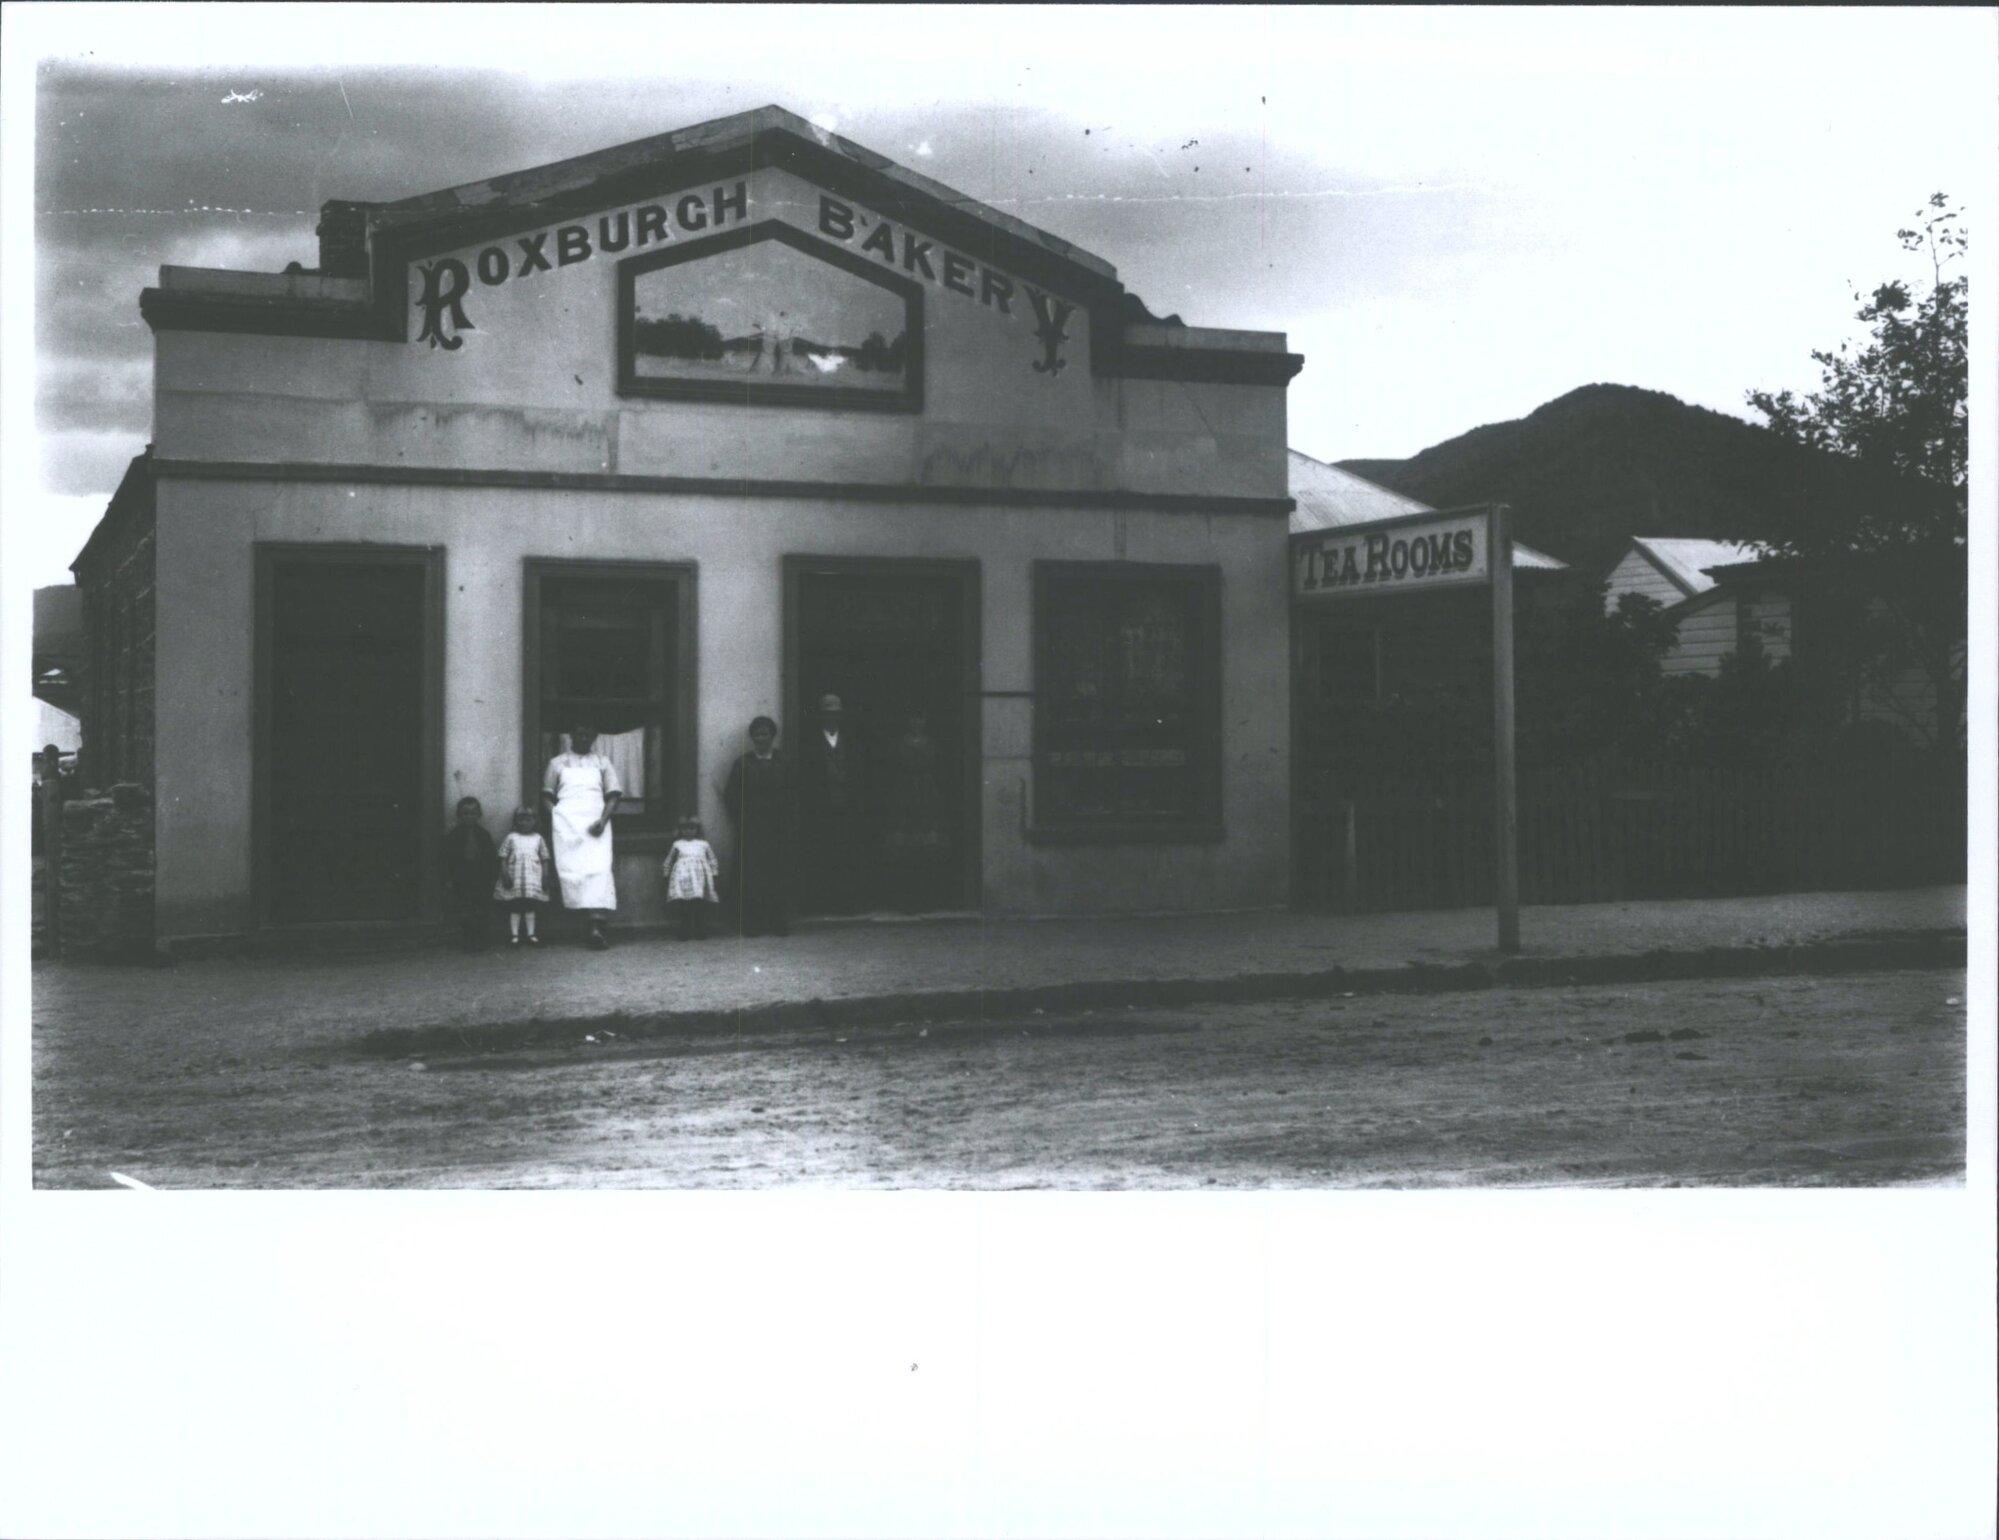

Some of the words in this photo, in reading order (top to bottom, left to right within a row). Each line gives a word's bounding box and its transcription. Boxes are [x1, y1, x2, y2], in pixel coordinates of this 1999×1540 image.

[415, 182, 748, 350] ROXBURGH
[819, 195, 1076, 376] BAKERY
[1298, 544, 1359, 589] TEA
[1362, 530, 1474, 580] ROOMS
